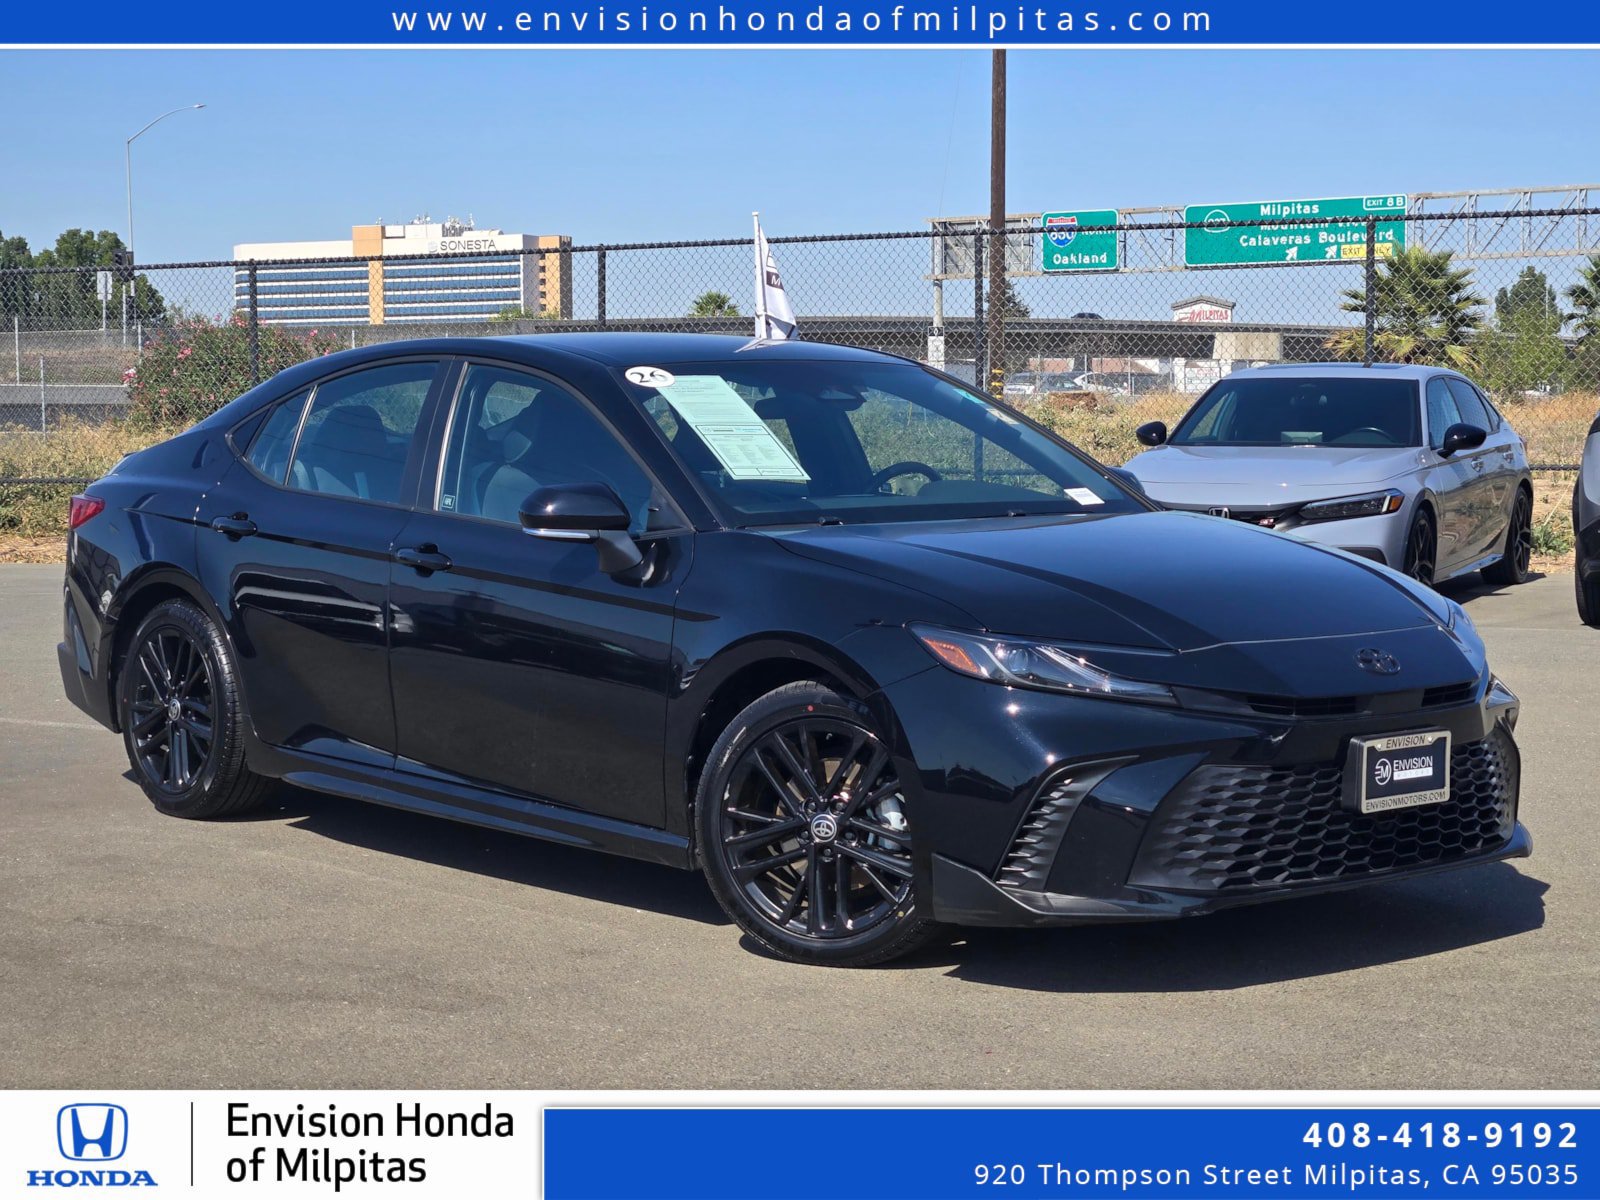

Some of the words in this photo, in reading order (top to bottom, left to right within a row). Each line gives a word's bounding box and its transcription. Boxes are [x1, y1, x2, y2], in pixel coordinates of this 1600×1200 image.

[1260, 203, 1320, 217] Milpitas
[1366, 199, 1384, 207] EXIT
[1240, 234, 1311, 247] Calaveras
[1318, 229, 1394, 244] Boulevrd
[440, 240, 496, 251] SONESTA
[1342, 247, 1361, 256] EXIT
[1053, 252, 1107, 264] Oakland
[1386, 735, 1425, 749] ENVISION
[1393, 756, 1433, 771] ENVISION
[1366, 791, 1446, 811] ENVISIONMOTORS.COM
